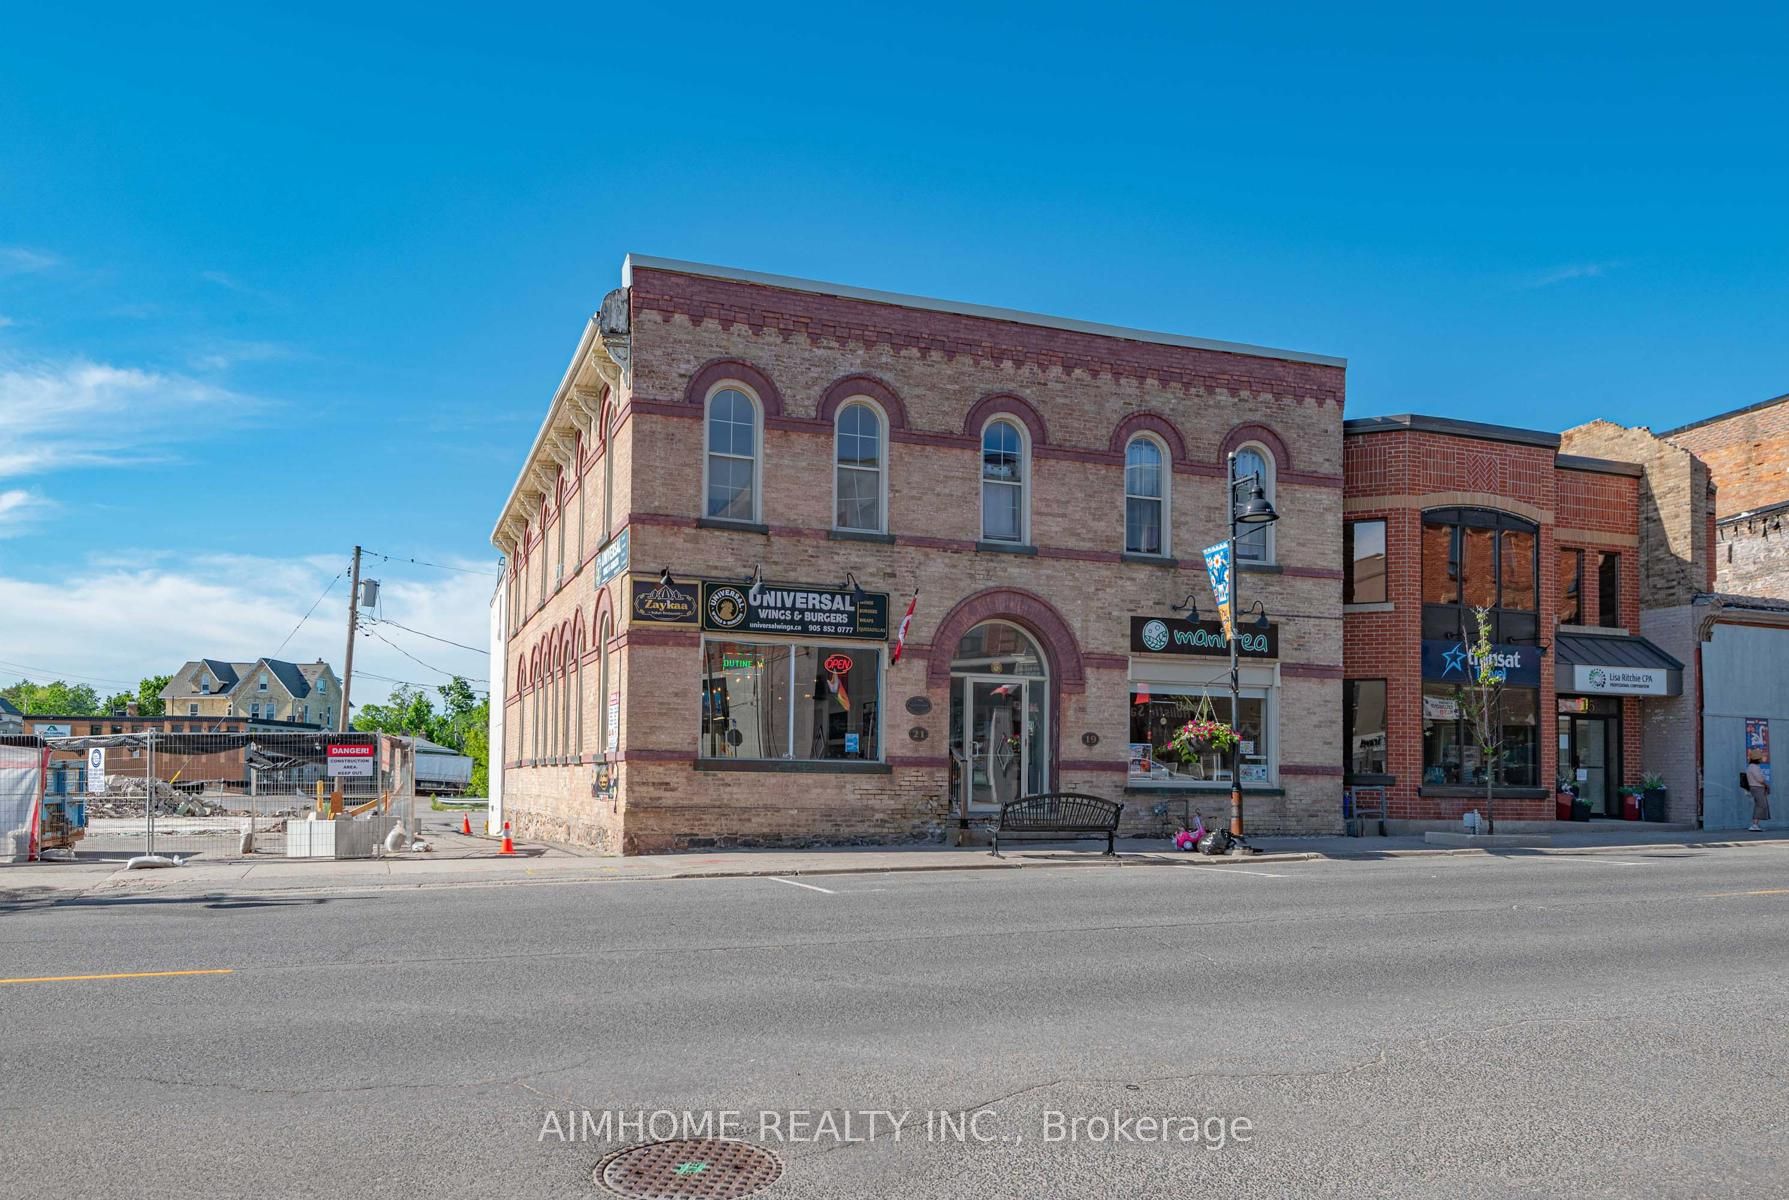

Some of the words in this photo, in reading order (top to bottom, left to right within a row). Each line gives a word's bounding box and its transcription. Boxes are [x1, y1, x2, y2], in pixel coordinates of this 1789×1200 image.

[711, 589, 744, 608] UNIVERSAL
[749, 589, 855, 611] UNIVERSAL
[644, 599, 688, 611] Zaykaa
[758, 608, 791, 620] WINGS
[794, 611, 802, 620] &
[804, 611, 848, 623] BURGERS
[749, 621, 802, 632] universalwings.ca
[822, 625, 836, 633] 852
[1174, 628, 1268, 653] maniea
[825, 659, 850, 670] OPEN
[1610, 672, 1621, 681] Lisa
[1622, 672, 1641, 682] Ritchie
[1642, 674, 1653, 683] CPA
[912, 729, 925, 738] 21
